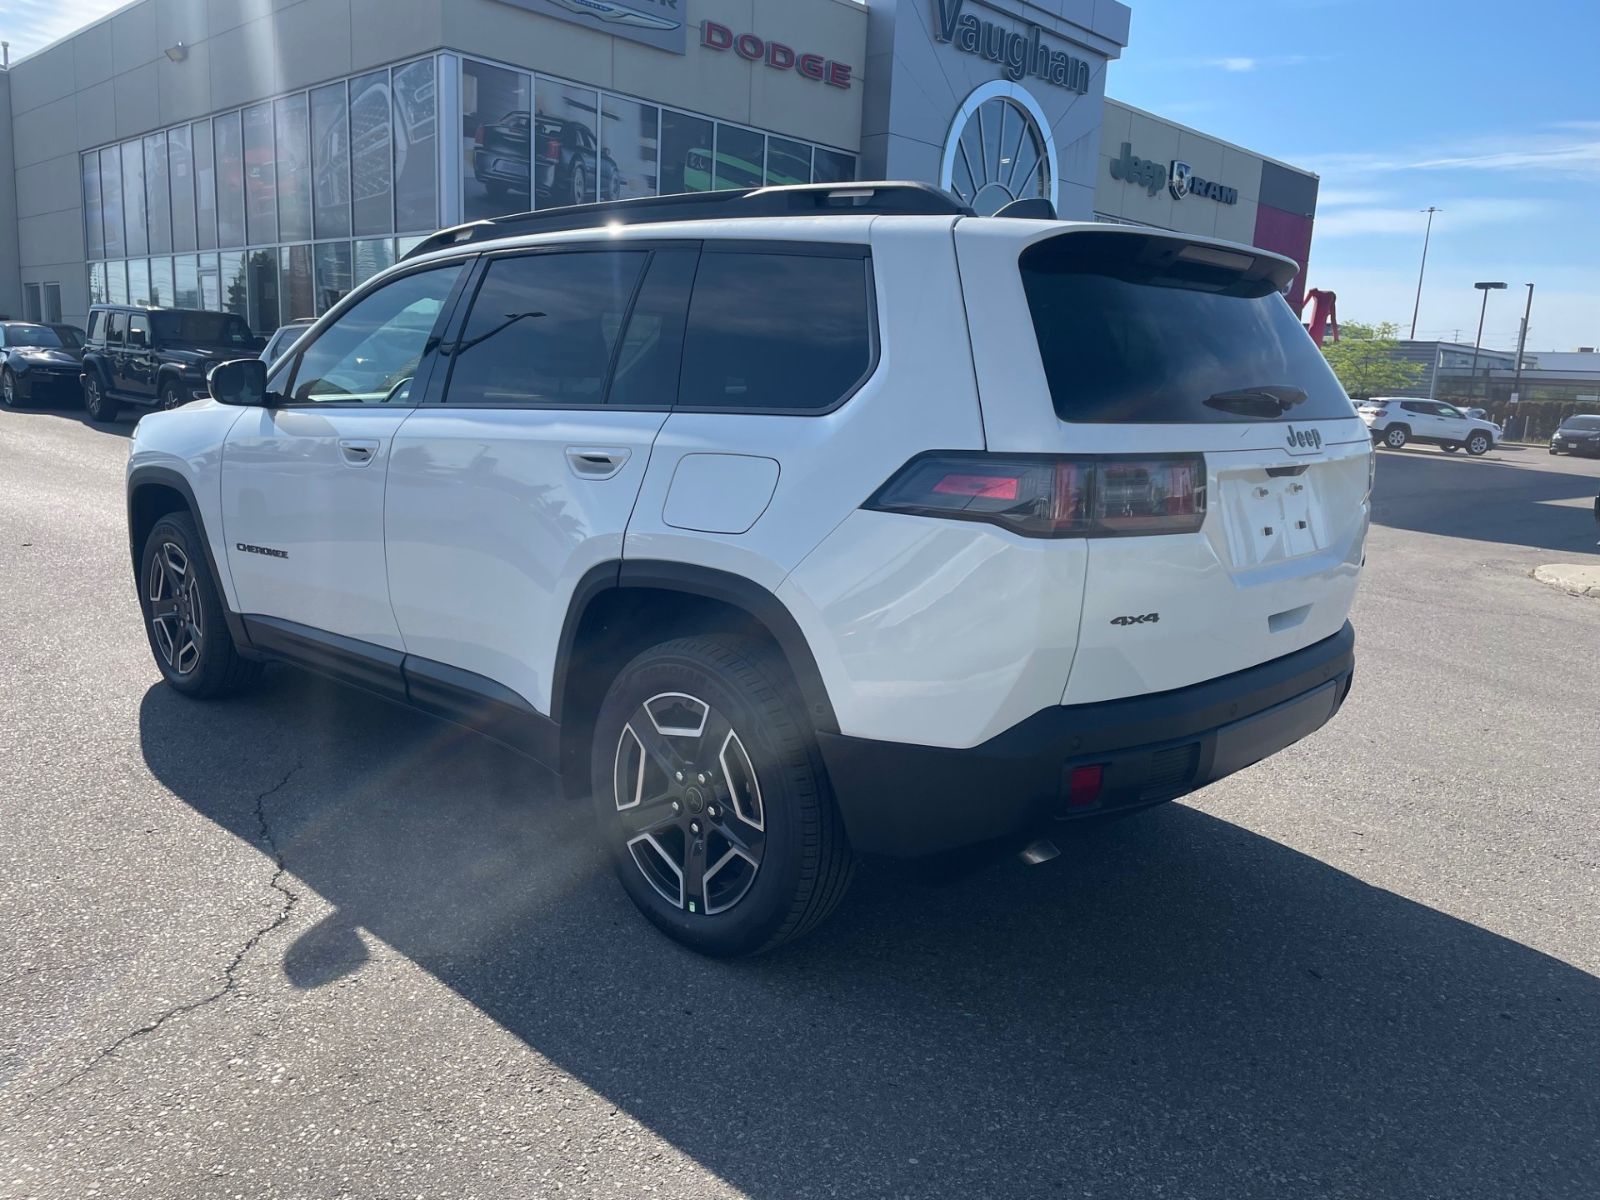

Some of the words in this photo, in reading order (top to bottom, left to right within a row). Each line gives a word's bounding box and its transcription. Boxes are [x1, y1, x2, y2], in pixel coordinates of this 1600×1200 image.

[700, 19, 852, 90] DODGE
[931, 0, 1090, 95] Vaughan
[1110, 142, 1166, 197] Jeep
[1189, 176, 1238, 205] RAM
[1286, 424, 1322, 450] Jeep
[236, 542, 289, 559] CHEROKEE
